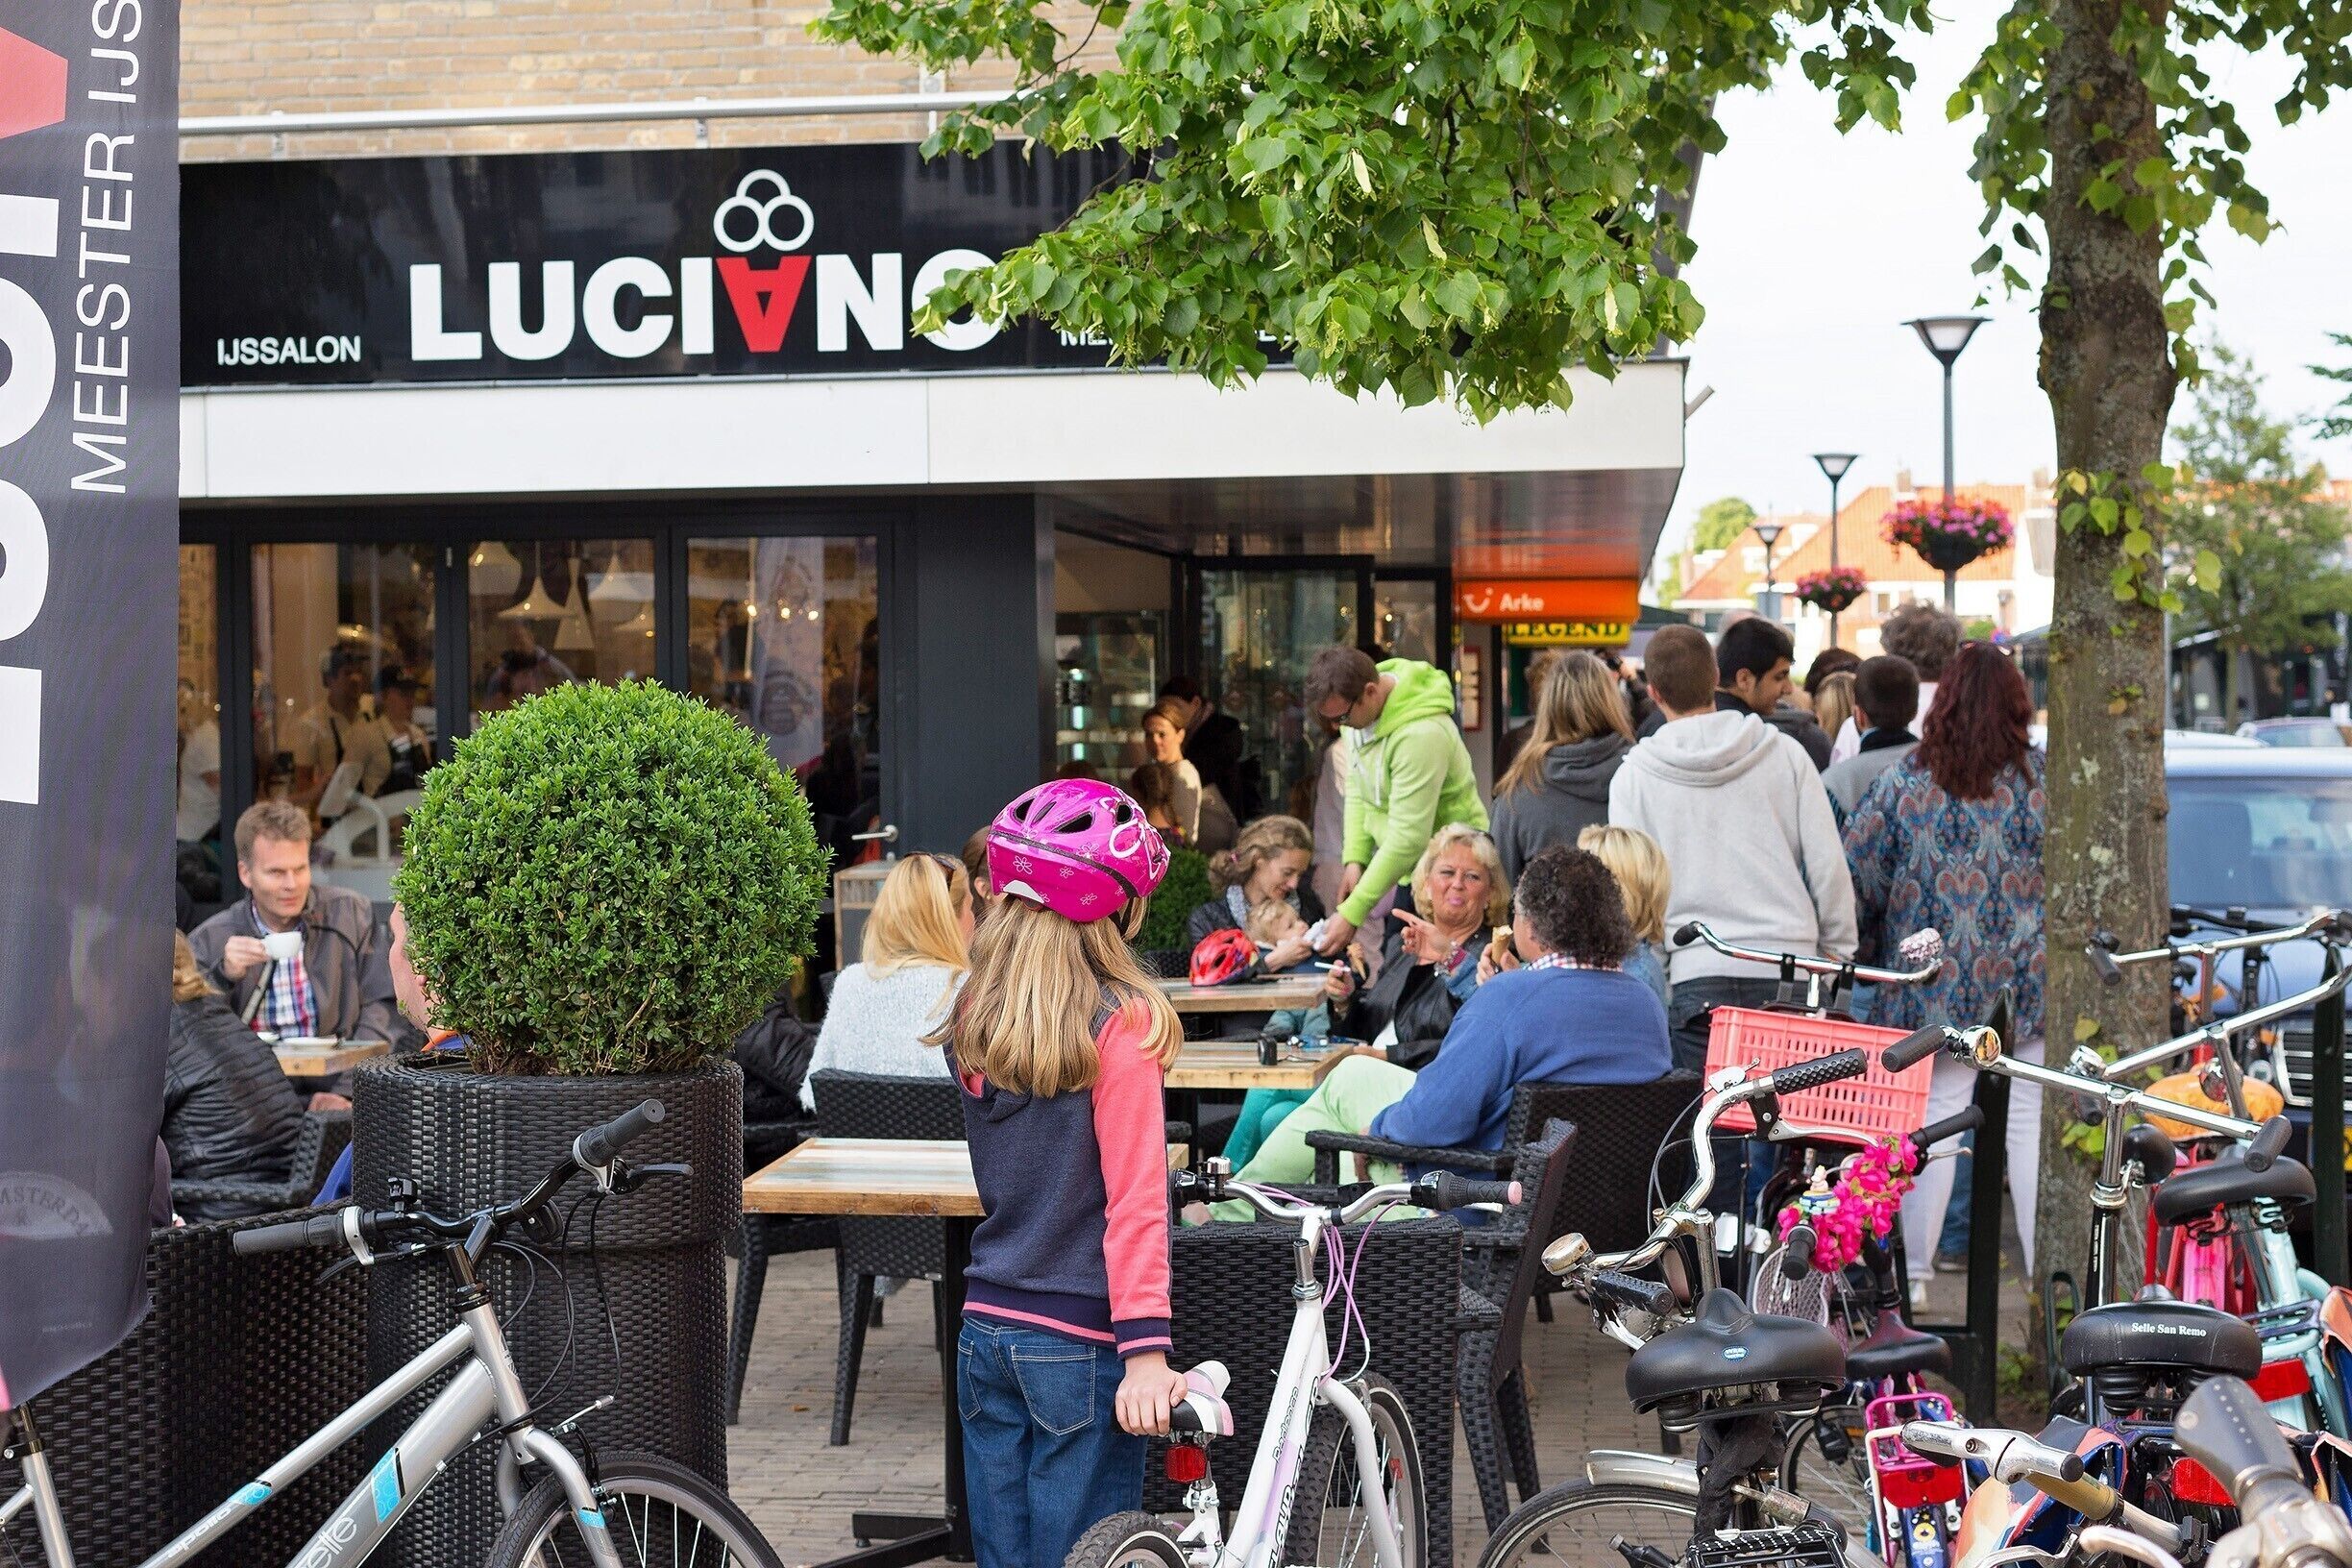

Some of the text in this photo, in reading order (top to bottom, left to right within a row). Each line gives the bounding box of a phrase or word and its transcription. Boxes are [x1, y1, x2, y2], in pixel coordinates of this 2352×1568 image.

[71, 134, 135, 494] MEESTER
[217, 335, 361, 366] IJSSALON
[1499, 593, 1545, 613] Arke
[1509, 623, 1622, 637] LEGEND
[2131, 1322, 2207, 1336] Selle San Remo
